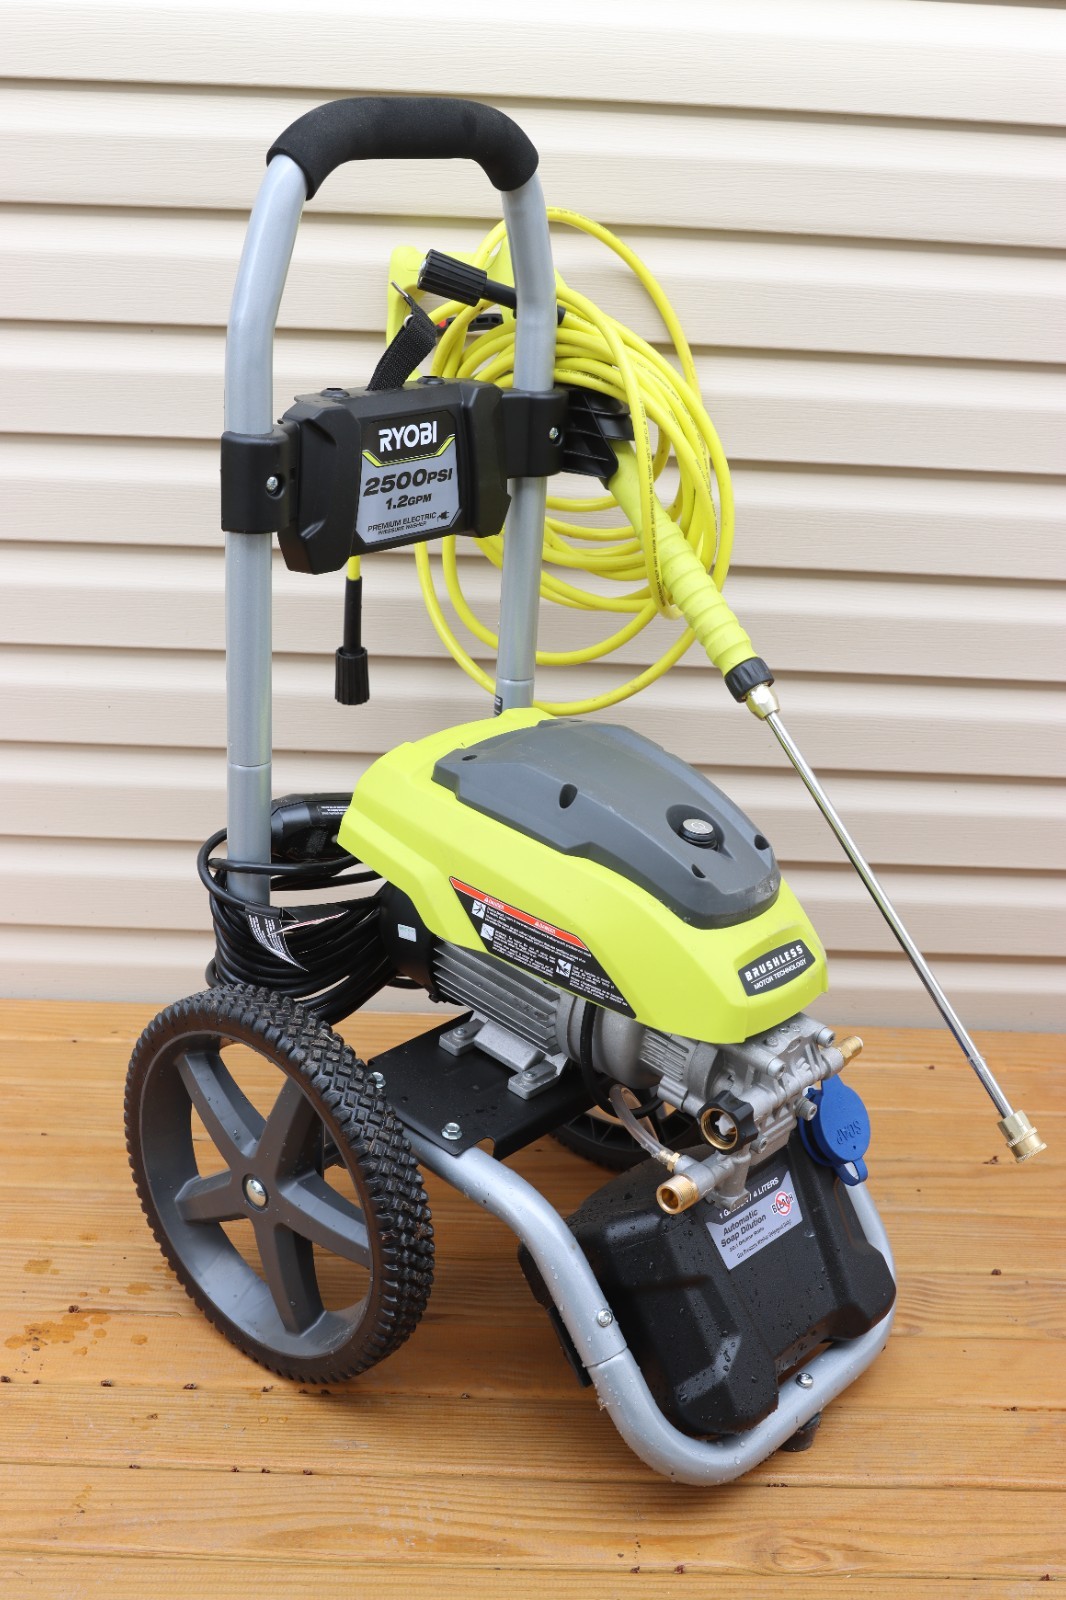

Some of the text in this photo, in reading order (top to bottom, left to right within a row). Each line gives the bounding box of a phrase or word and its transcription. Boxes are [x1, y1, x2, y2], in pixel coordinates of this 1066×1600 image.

[378, 421, 438, 453] RYOBI
[367, 511, 437, 532] PREMIUM ELECTRIC
[405, 521, 427, 531] WASHER
[744, 944, 804, 982] BRUSHLESS
[753, 957, 807, 990] MOTOR TECHNOLOGY
[836, 1120, 862, 1145] SOAP
[757, 1176, 780, 1195] LITERS
[771, 1193, 794, 1214] BLEACH
[720, 1232, 740, 1248] Soap
[740, 1214, 767, 1235] Dilution
[723, 1208, 759, 1237] Automatic
